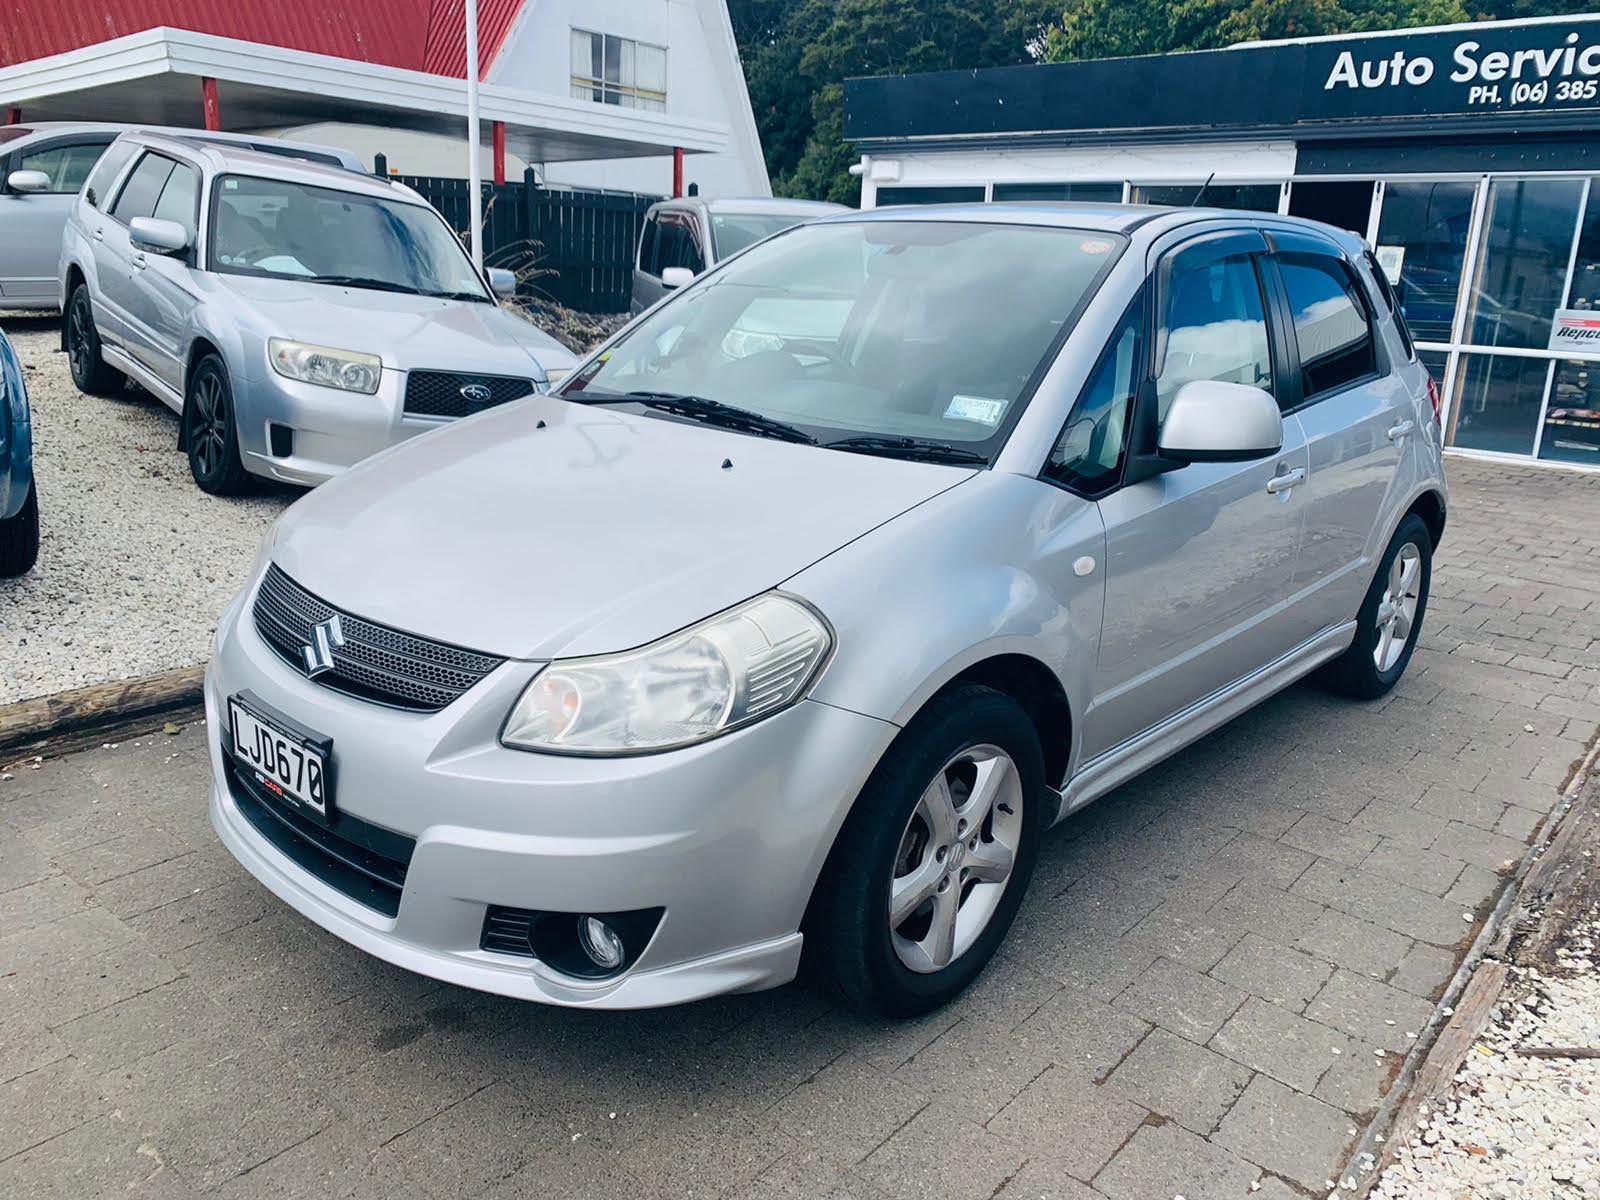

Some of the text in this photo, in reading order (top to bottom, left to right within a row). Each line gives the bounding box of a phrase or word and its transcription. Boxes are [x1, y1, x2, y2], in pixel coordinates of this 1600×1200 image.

[1324, 32, 1600, 89] Auto Servic
[1468, 80, 1598, 105] PH. (06) 385
[234, 710, 324, 805] LJD670
